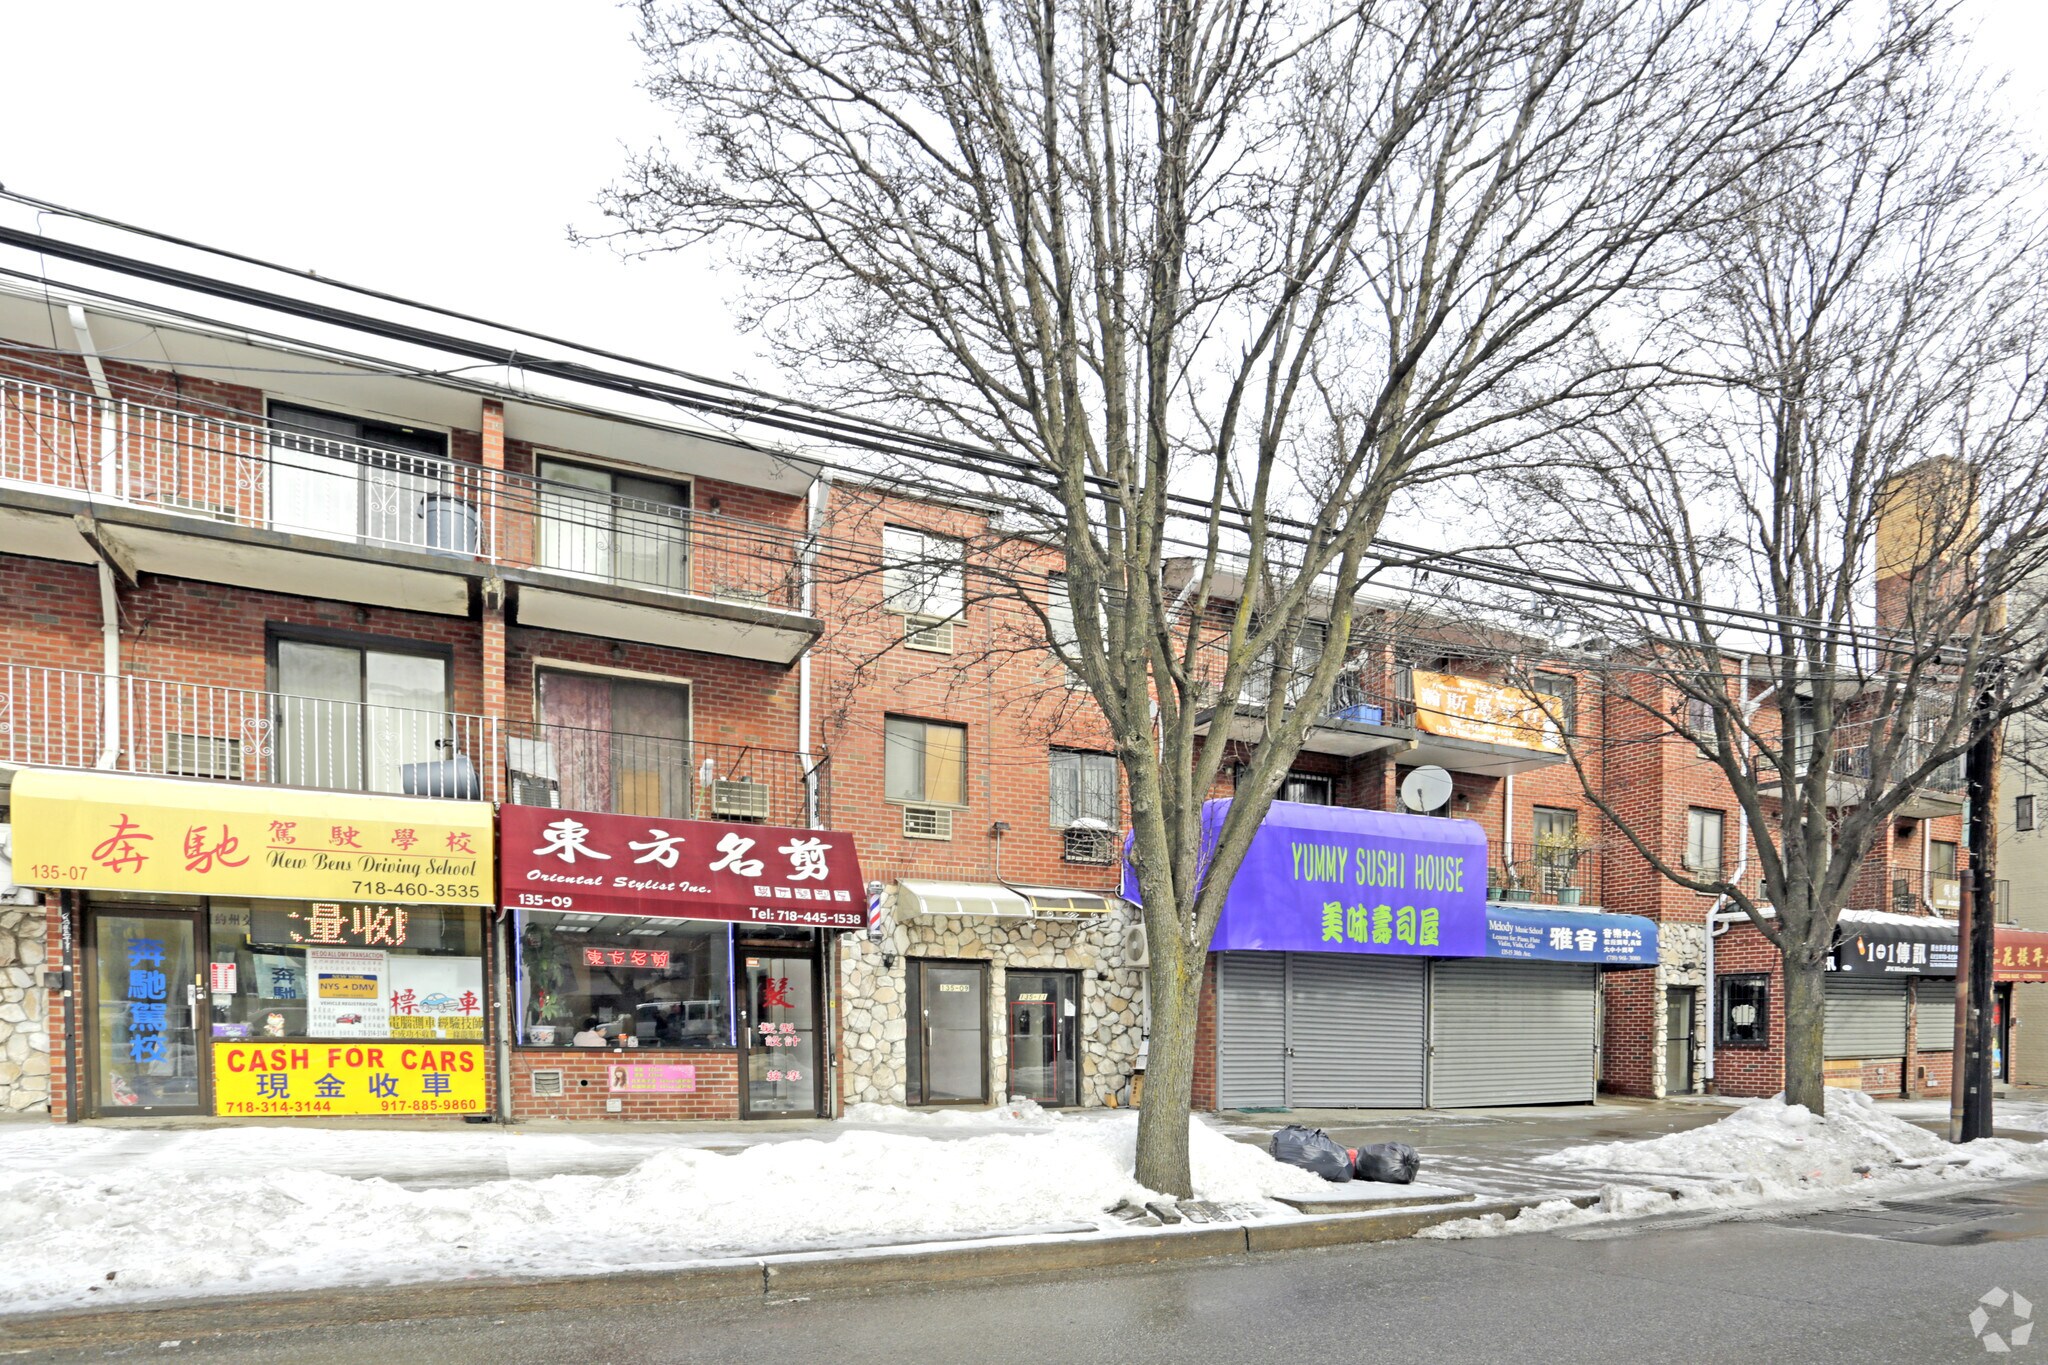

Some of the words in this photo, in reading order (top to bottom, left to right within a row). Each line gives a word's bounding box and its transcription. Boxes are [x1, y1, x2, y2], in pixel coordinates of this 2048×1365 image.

[91, 813, 250, 874] 奔馳
[266, 820, 477, 855] 駕駛學校
[533, 817, 833, 882] 東方名剪
[31, 864, 88, 881] 135-07
[266, 850, 309, 870] New
[313, 852, 353, 872] Bens
[357, 855, 421, 878] Driving
[425, 857, 477, 878] School
[1291, 842, 1348, 883] YUMMY
[1355, 848, 1405, 888] SUSHI
[1414, 854, 1464, 893] HOUSE
[352, 880, 480, 898] 718-460-3535
[526, 868, 603, 887] Oriental
[613, 876, 684, 892] Stylist
[680, 881, 712, 894] Inc.
[518, 893, 573, 908] 135-09
[749, 907, 775, 920] Tel:
[777, 910, 861, 925] 718-445-1538
[1321, 901, 1440, 947] 美味壽司屋
[1549, 927, 1598, 952] 雅音
[1602, 928, 1642, 939] 音樂中心
[586, 950, 670, 967] 東方名剪
[127, 937, 168, 1064] 奔馳駕校
[941, 984, 969, 992] 135-09
[390, 988, 420, 1015] 標
[457, 990, 480, 1015] 車
[227, 1048, 309, 1072] CASH
[328, 1048, 383, 1070] FOR
[400, 1048, 475, 1071] CARS
[257, 1073, 453, 1099] 現金收車
[226, 1101, 332, 1114] 718-314-3144
[381, 1098, 477, 1112] 917-885-9860
